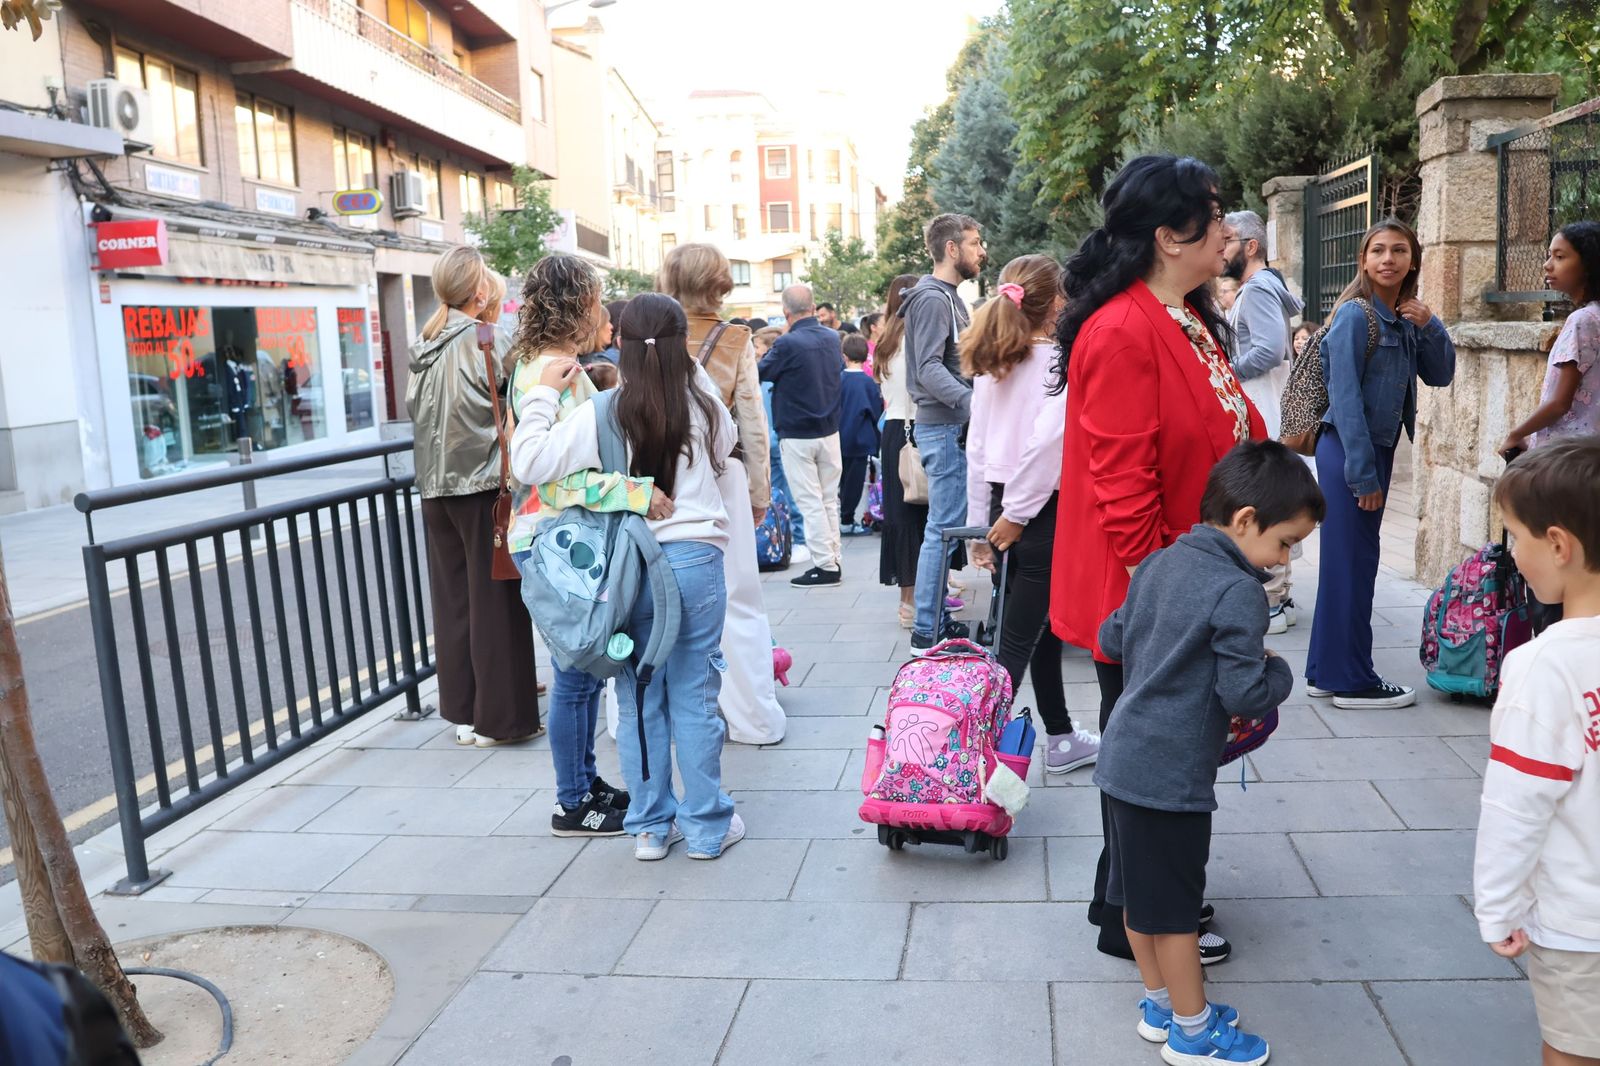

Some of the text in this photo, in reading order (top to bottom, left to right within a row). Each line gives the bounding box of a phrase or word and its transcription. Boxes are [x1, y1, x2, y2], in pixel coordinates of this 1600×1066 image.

[98, 236, 157, 251] CORNER
[124, 306, 209, 338] REBAJAS
[128, 341, 153, 357] TODO
